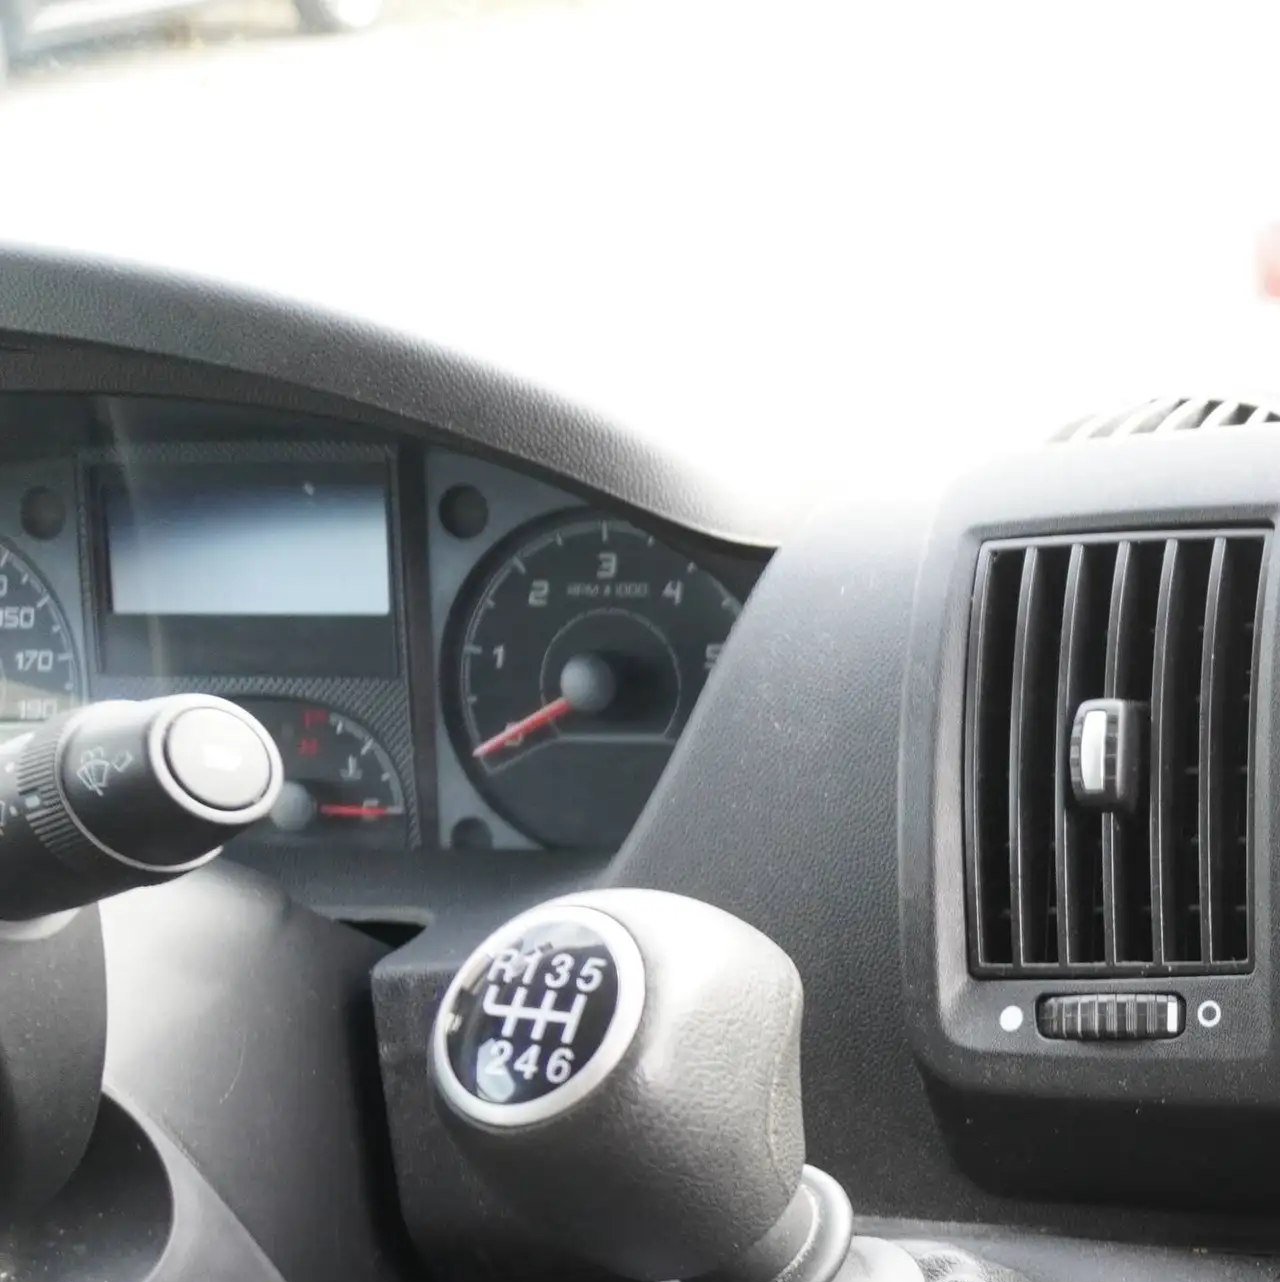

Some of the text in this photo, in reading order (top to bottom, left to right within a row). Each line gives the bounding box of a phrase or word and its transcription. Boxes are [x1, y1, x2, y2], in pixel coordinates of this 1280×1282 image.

[596, 551, 619, 580] 3
[528, 579, 550, 608] 2
[661, 579, 684, 608] 4
[15, 648, 53, 672] 170
[492, 643, 506, 670] 1
